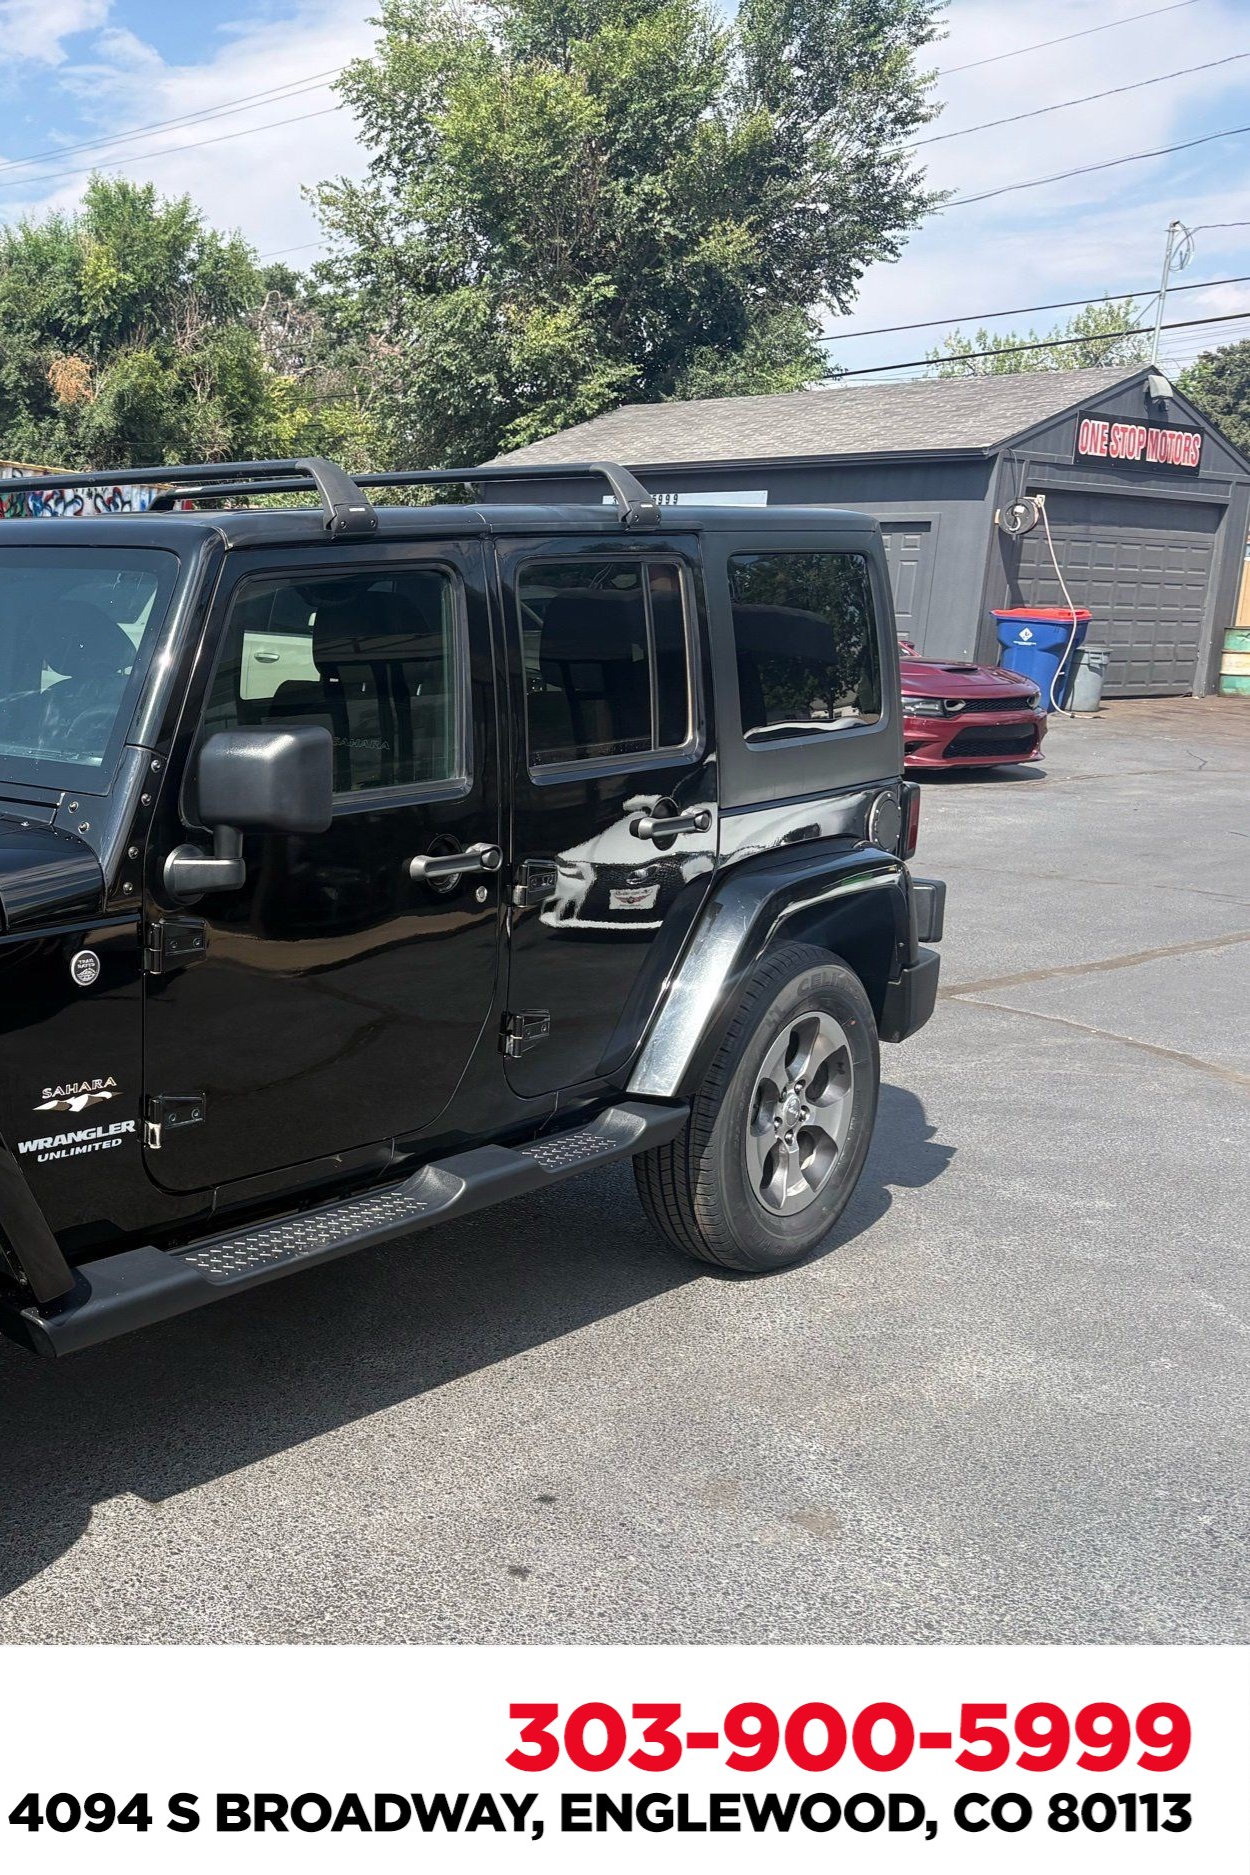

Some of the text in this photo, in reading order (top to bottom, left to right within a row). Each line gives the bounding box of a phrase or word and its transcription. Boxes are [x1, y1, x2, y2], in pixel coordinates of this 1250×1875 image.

[1078, 419, 1202, 467] ONE STOP MOTORS
[42, 1076, 117, 1099] SAHARA
[17, 1120, 137, 1154] WRANGLER
[37, 1138, 123, 1163] UNLIMITED
